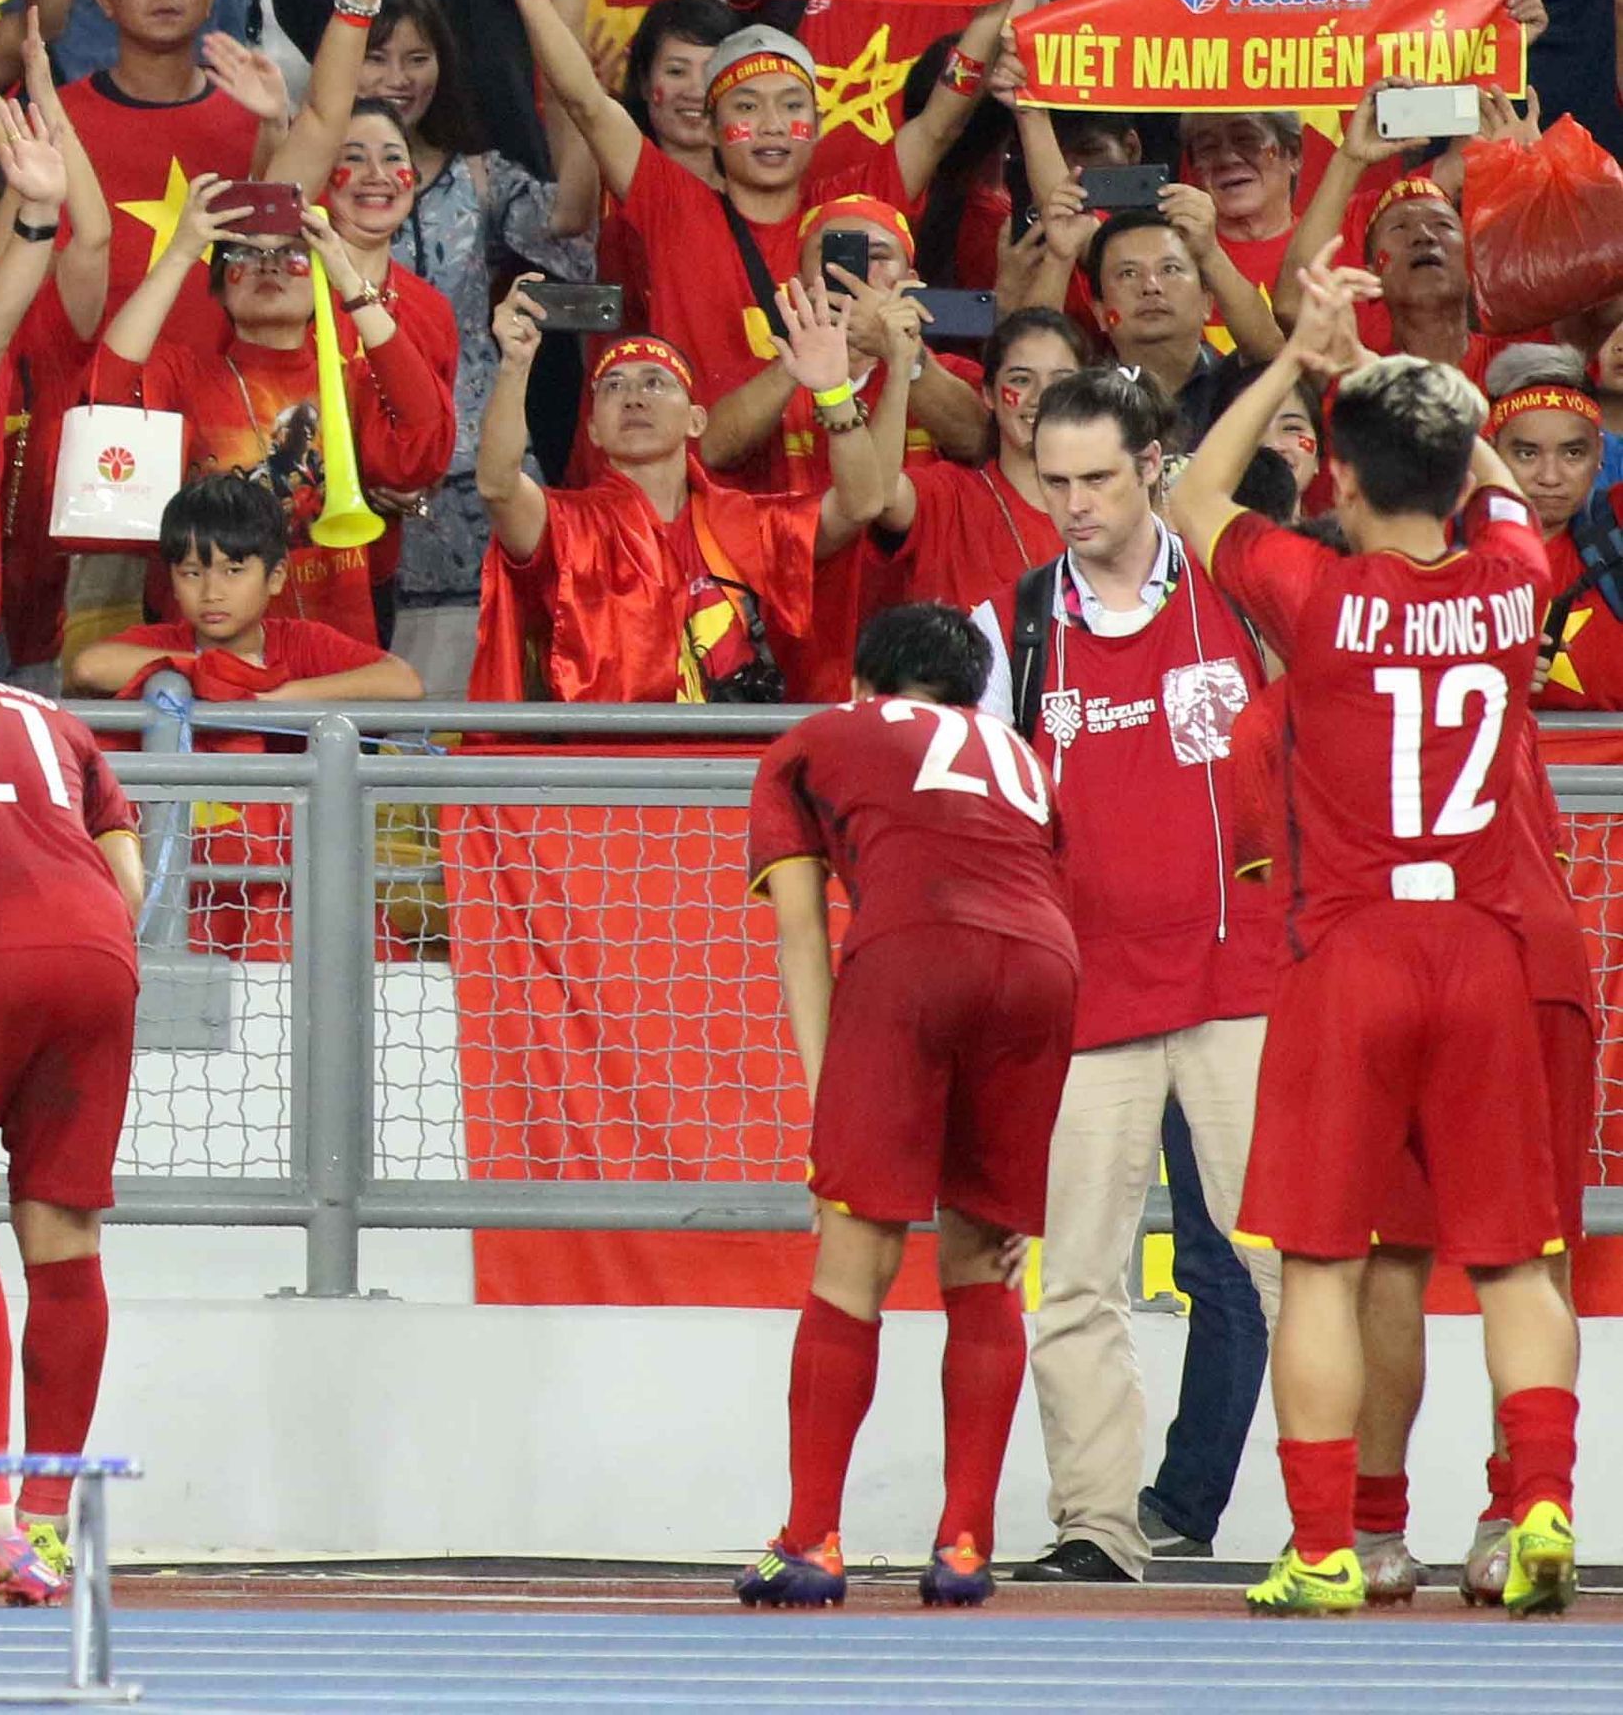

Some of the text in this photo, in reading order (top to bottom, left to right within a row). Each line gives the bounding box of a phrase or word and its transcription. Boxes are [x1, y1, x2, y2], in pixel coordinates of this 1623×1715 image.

[1034, 11, 1498, 100] VIỆT NAM CHIẾN THẮNG
[1510, 392, 1541, 412] NAM
[1336, 584, 1536, 657] N.P. HONG DUY
[1085, 697, 1111, 710] AFF
[1086, 698, 1157, 723] SUZUKI
[1088, 713, 1150, 733] CUP 2018
[881, 694, 1051, 825] 20
[1373, 662, 1509, 838] 12
